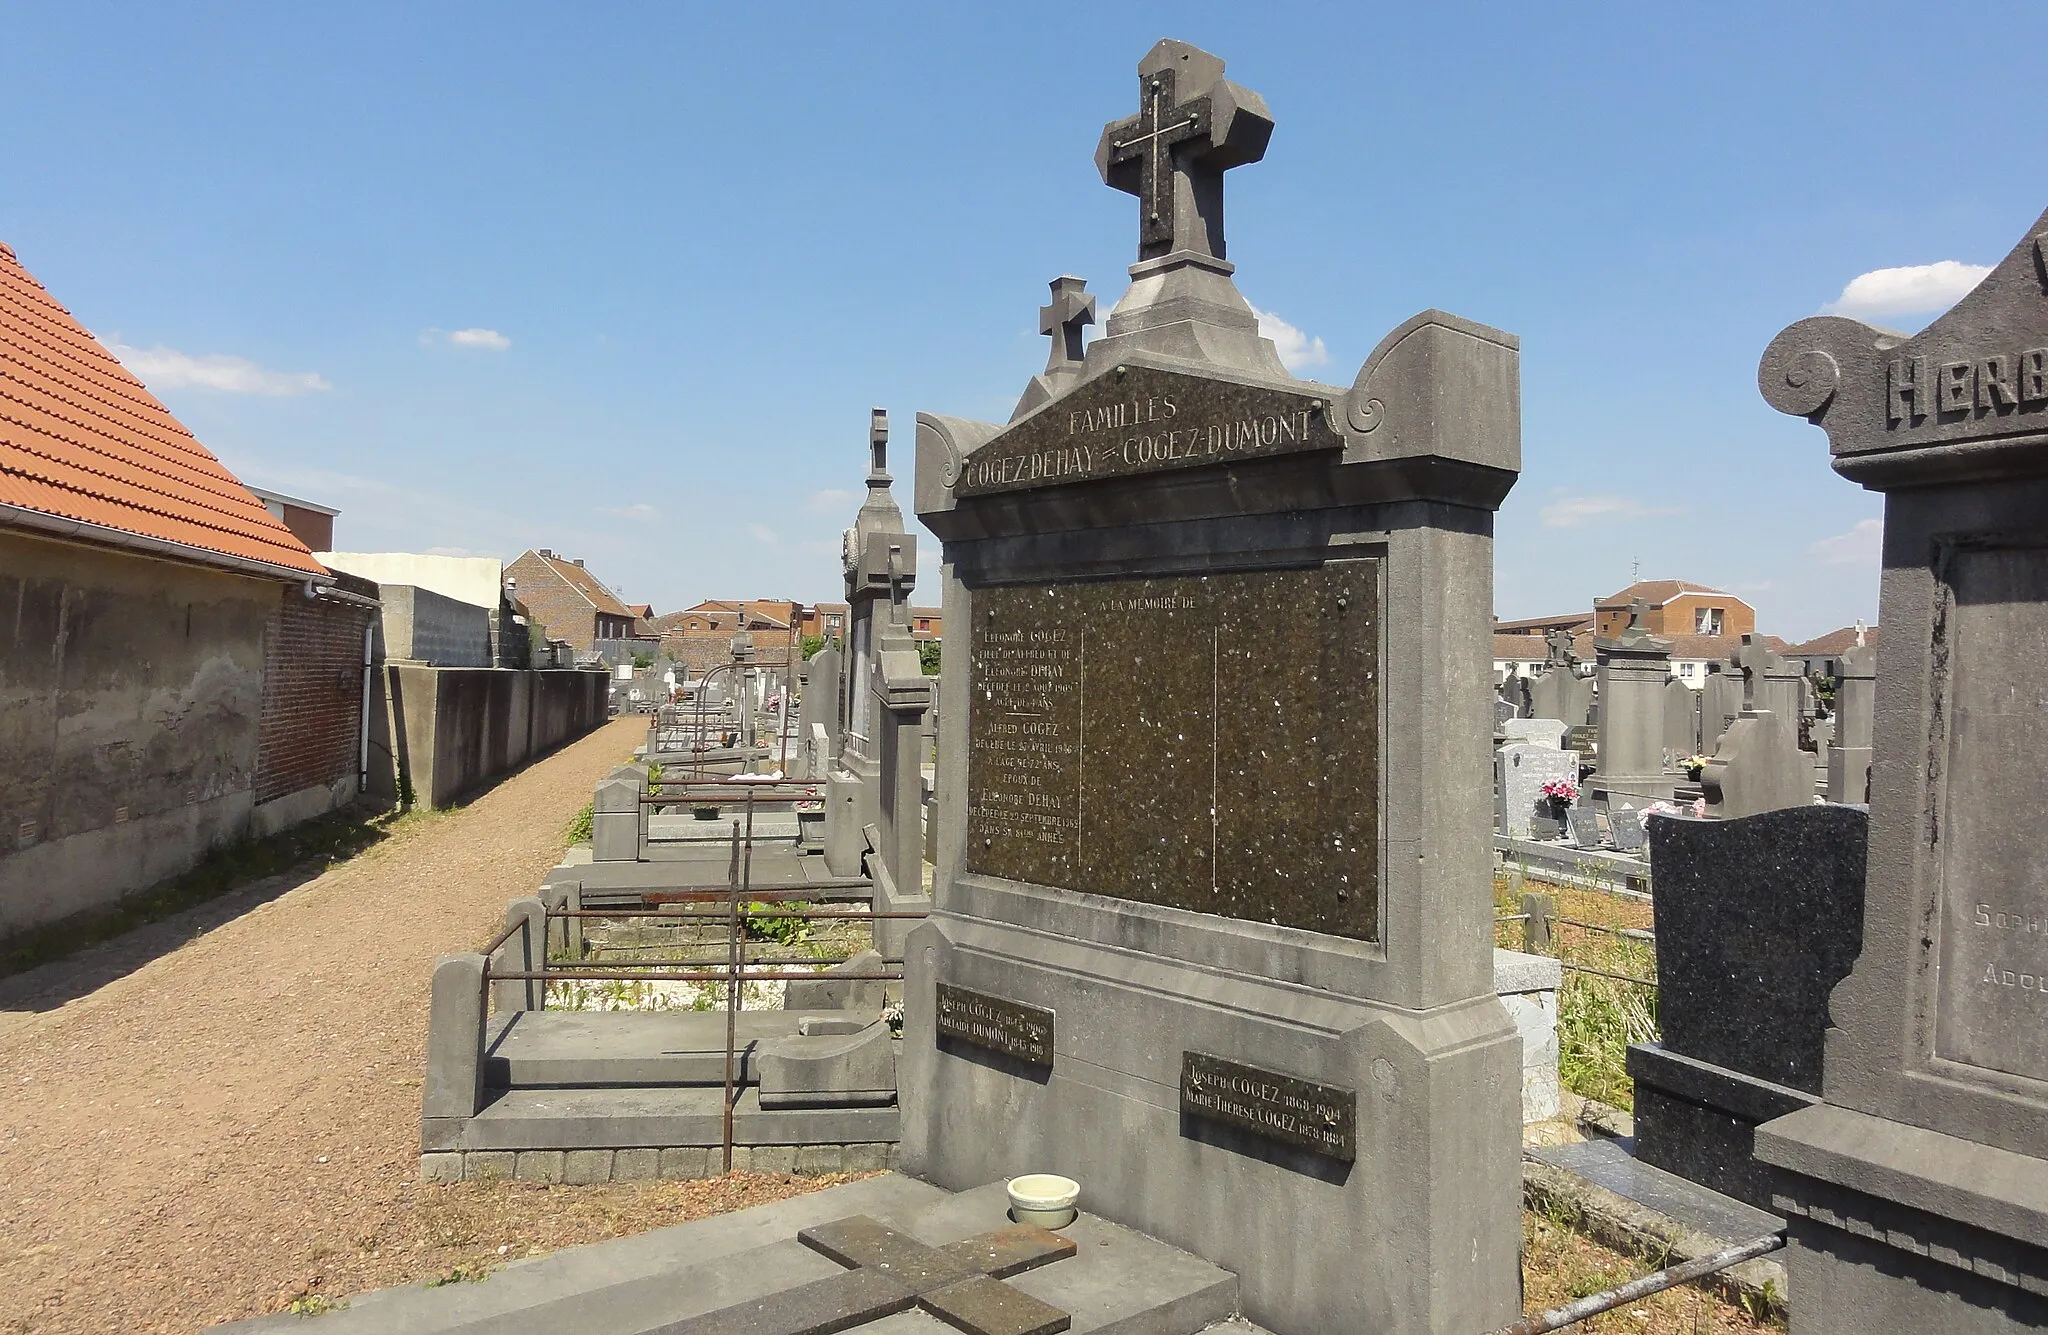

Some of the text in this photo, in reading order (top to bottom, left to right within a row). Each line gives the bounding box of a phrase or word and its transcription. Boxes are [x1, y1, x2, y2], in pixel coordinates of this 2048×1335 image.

[1068, 393, 1178, 435] FAMILLES
[966, 445, 1096, 488] COGEZ-DEHAY
[1123, 409, 1312, 466] COGEZ-DUMONT
[1111, 599, 1124, 611] LA
[1182, 596, 1196, 609] DE
[1030, 628, 1067, 642] COGEZ
[1015, 648, 1045, 659] ALFRED
[1048, 650, 1057, 659] ET
[1061, 650, 1071, 659] DE
[1030, 664, 1064, 677] DEHAY
[1038, 698, 1053, 708] ANS
[987, 722, 1059, 736] ALFRED COGEZ
[1007, 741, 1016, 751] LE
[1031, 742, 1053, 754] AVRIL
[1042, 760, 1059, 771] ANS
[1002, 773, 1042, 786] EPOUX DE
[1028, 792, 1062, 809] DEHAY
[1020, 812, 1061, 827] SEPTEMBRE
[979, 824, 1000, 835] DANS
[1003, 828, 1013, 838] SA
[939, 994, 966, 1013] JOSEPH
[968, 1000, 1002, 1023] COGEZ
[973, 1022, 1009, 1046] DUMONT
[1188, 1065, 1227, 1089] JOSEPH
[1232, 1075, 1280, 1104] COGEZ
[1257, 1106, 1296, 1132] COGEZ
